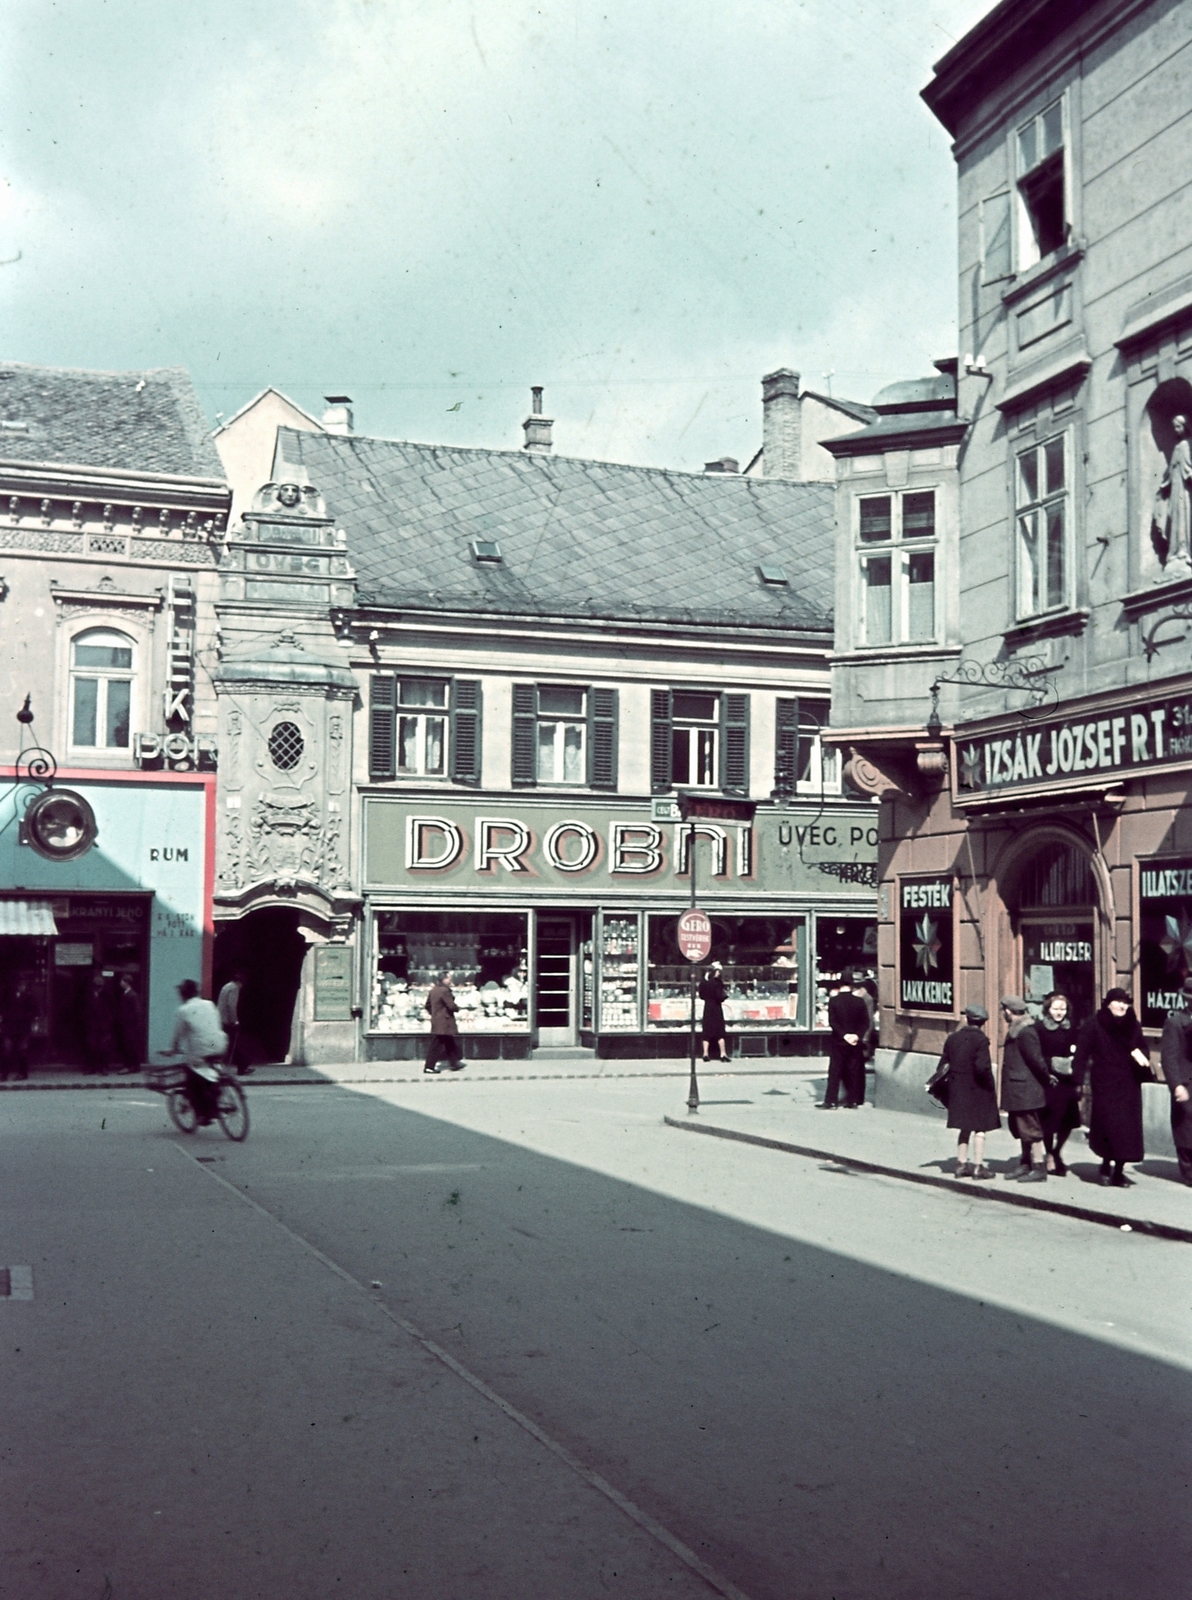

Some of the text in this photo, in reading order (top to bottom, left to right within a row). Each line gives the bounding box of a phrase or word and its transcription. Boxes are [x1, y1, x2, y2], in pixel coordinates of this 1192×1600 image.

[984, 731, 1043, 785] IZSÁK
[1046, 717, 1127, 776] JÓZSEF
[150, 848, 189, 862] RUM
[405, 814, 757, 879] DROBNI
[903, 880, 950, 908] FESTÉK
[1040, 941, 1091, 961] ILLATSZER
[924, 981, 953, 1005] KENCE
